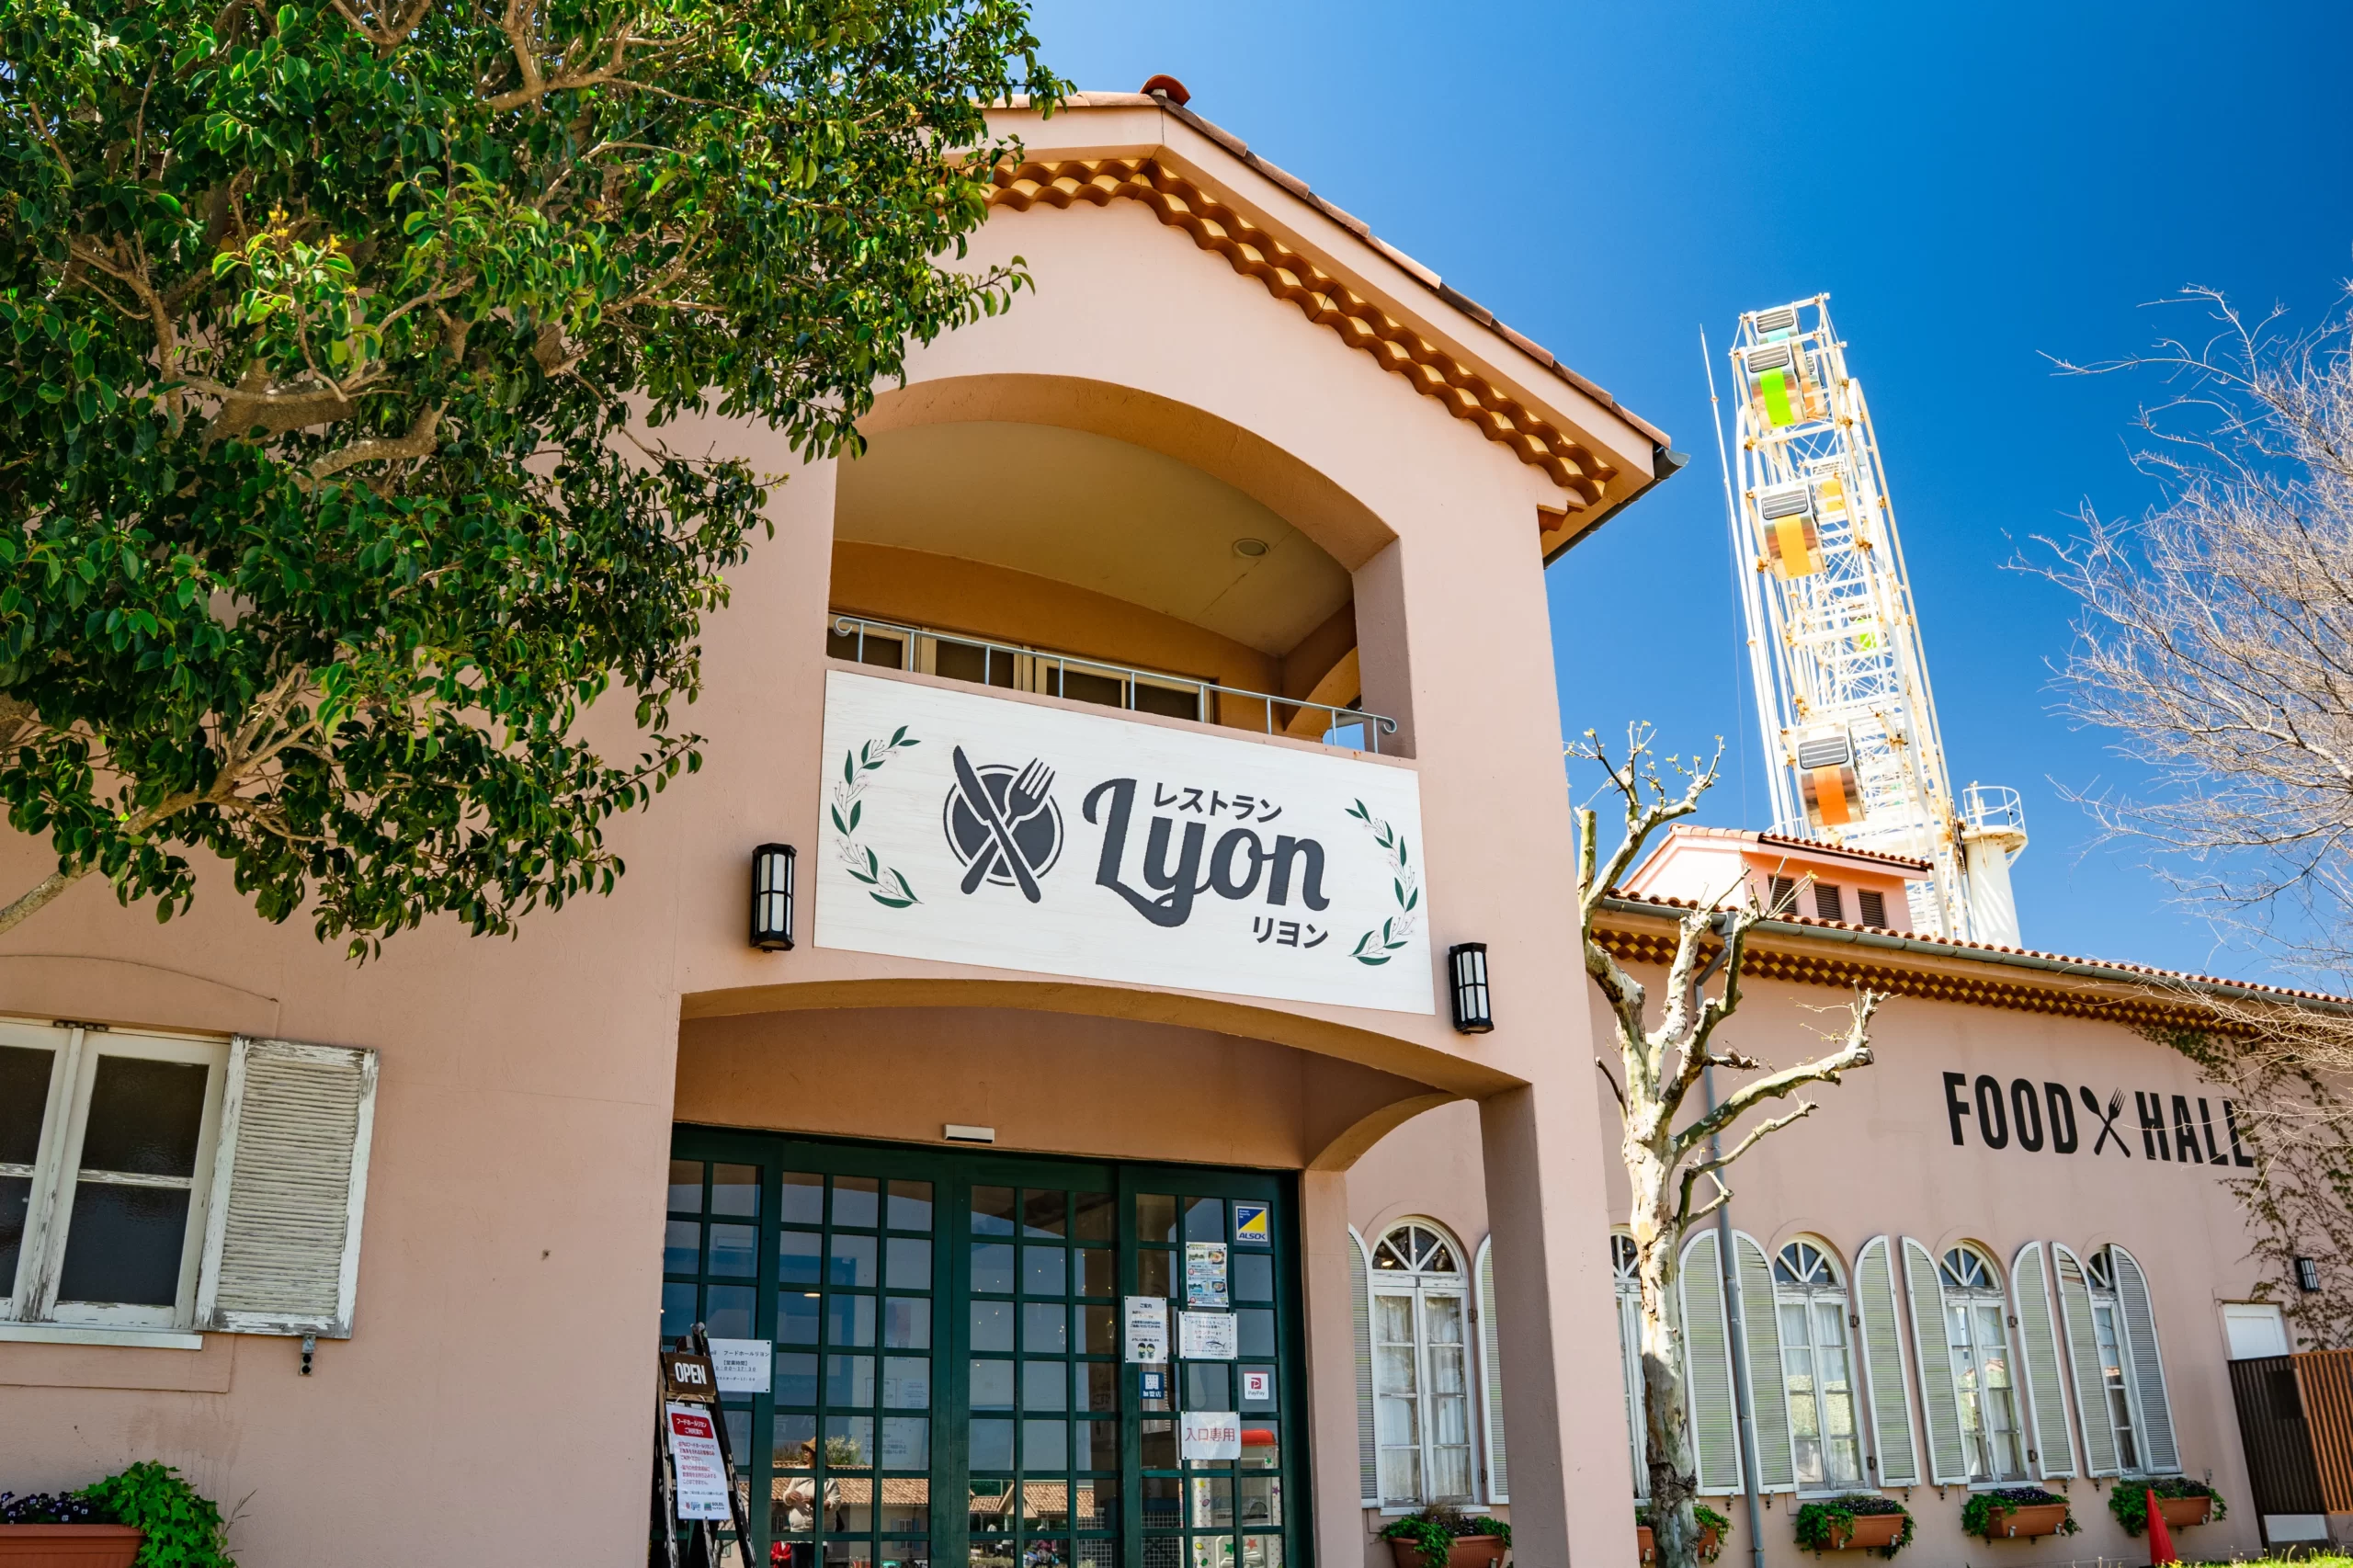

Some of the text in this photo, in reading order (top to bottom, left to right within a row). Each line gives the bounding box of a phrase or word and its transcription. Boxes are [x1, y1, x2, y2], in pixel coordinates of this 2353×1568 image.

[1153, 781, 1282, 823] レストラン
[1082, 778, 1330, 926] Lyon
[1253, 916, 1329, 949] リヨン
[1942, 1071, 2254, 1167] FOOD HALL
[675, 1361, 707, 1385] OPEN
[1185, 1427, 1235, 1442] 入口専用
